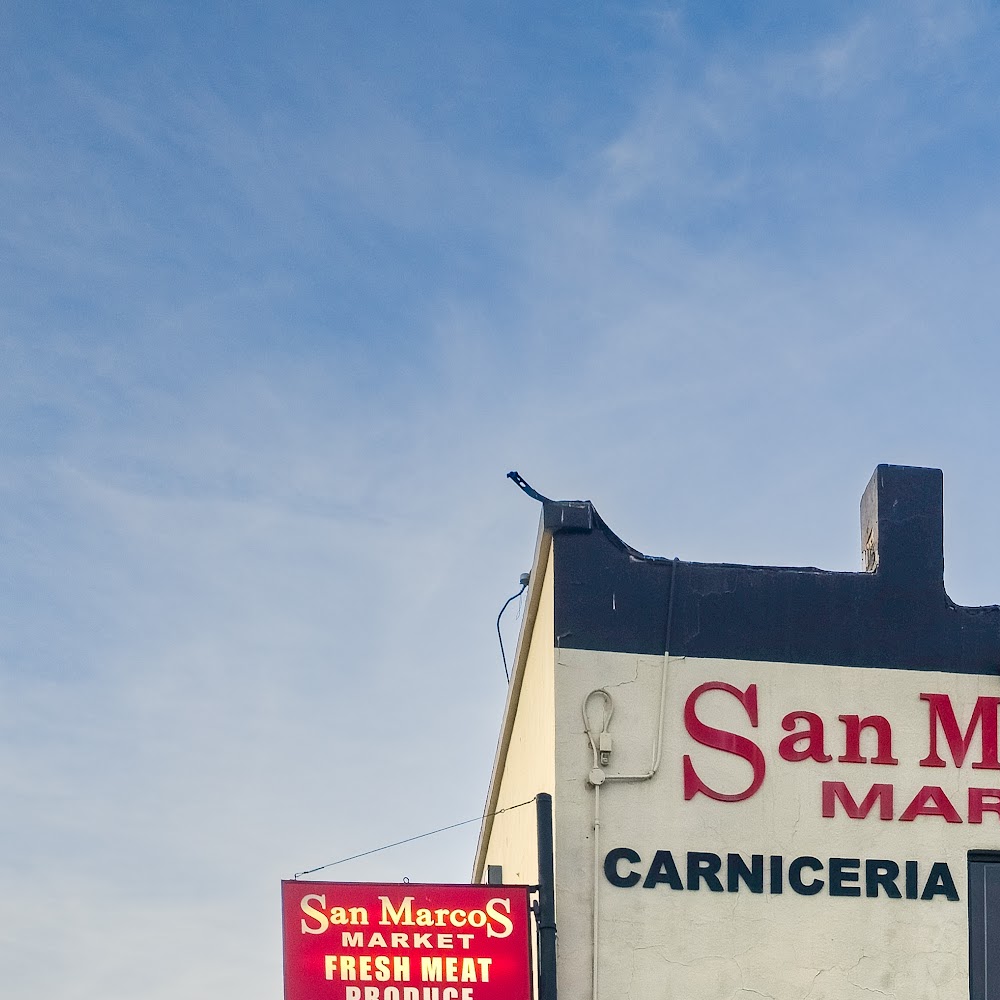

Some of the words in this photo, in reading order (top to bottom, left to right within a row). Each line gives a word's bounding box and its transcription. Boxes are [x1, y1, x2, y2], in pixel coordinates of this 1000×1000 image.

[684, 680, 897, 802] San
[604, 847, 960, 901] CARNICERIA
[300, 894, 370, 934] San
[341, 932, 475, 949] MARKET
[324, 955, 411, 982] FRESH
[421, 957, 493, 983] MEAT
